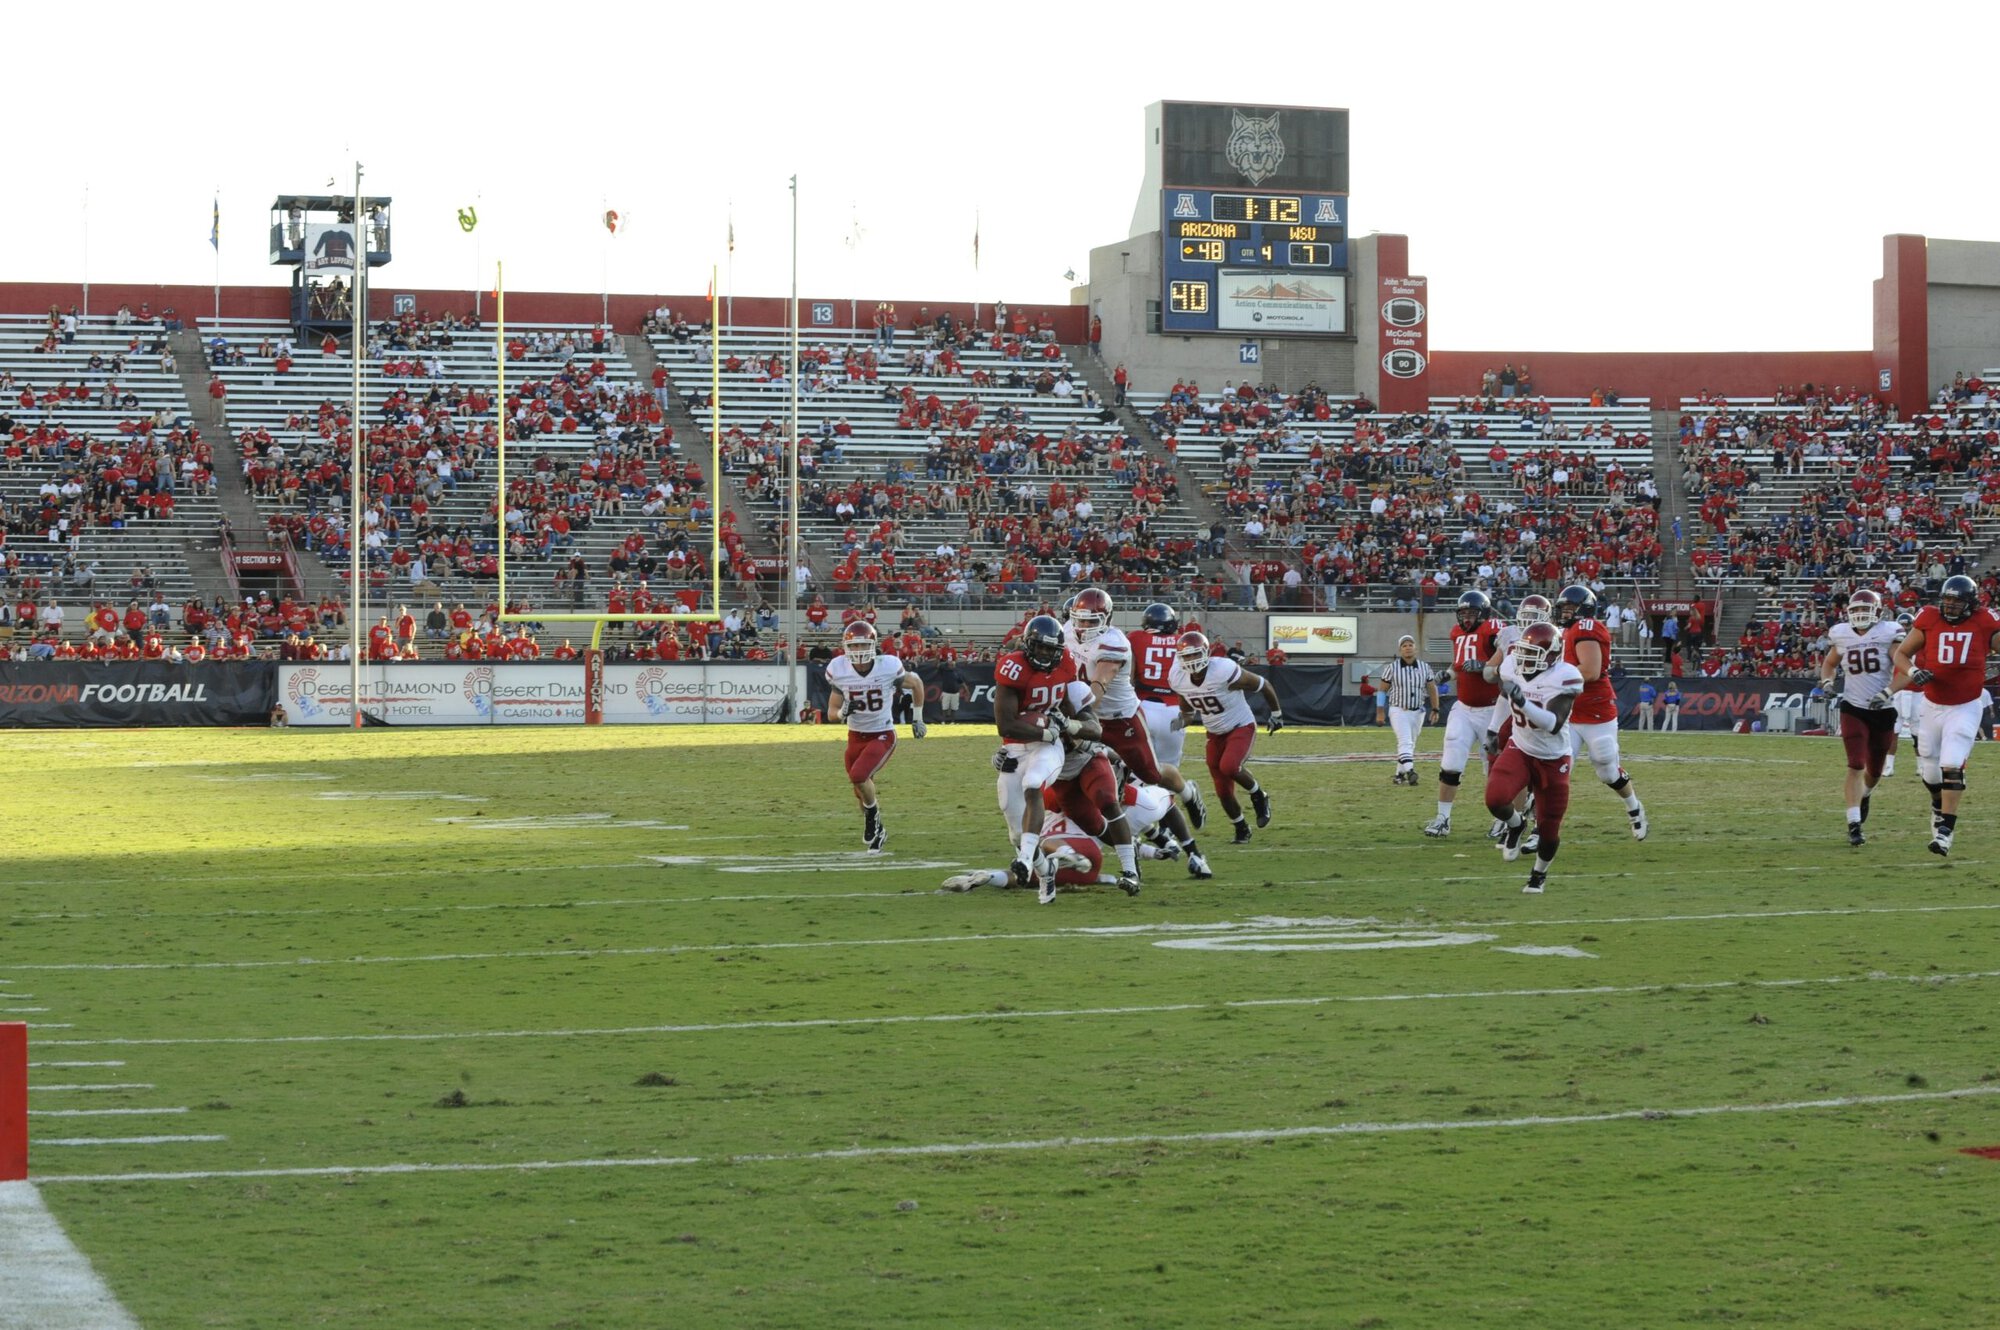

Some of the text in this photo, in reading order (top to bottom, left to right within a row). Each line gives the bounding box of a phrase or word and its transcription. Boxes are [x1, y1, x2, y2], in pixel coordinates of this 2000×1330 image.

[1246, 198, 1298, 222] 1:12
[1181, 222, 1236, 238] ARIZONA
[1289, 226, 1317, 241] WSU
[1199, 241, 1223, 260] 48
[1241, 248, 1255, 257] QTR
[1261, 245, 1272, 261] 4
[1302, 245, 1314, 263] 7
[1384, 278, 1398, 286] John
[396, 298, 414, 312] 12
[1172, 284, 1206, 311] 40
[814, 306, 832, 321] 13
[1385, 329, 1422, 338] McCollins
[1393, 338, 1415, 346] Umeh
[1240, 346, 1258, 360] 14
[1880, 372, 1890, 387] 15
[242, 556, 268, 564] SECTION
[760, 609, 770, 617] 30
[1665, 603, 1690, 611] SECTION
[1578, 619, 1594, 631] 50
[1152, 636, 1176, 645] HAYES
[1332, 629, 1351, 637] 107.5
[1455, 634, 1478, 664] 76
[1938, 632, 1973, 664] 67
[1848, 648, 1880, 675] 96
[1000, 660, 1023, 680] 26
[375, 680, 456, 696] DIAMOND
[478, 680, 628, 697] DESERT DIAMND
[591, 654, 602, 712] ARIZONA
[650, 680, 716, 694] DESERT
[80, 684, 208, 702] FOOTBALL
[848, 689, 884, 712] 56
[329, 706, 433, 716] CASNO HOTEL
[503, 708, 553, 718] CASINO
[676, 706, 724, 716] CASINO
[1190, 696, 1224, 715] 99
